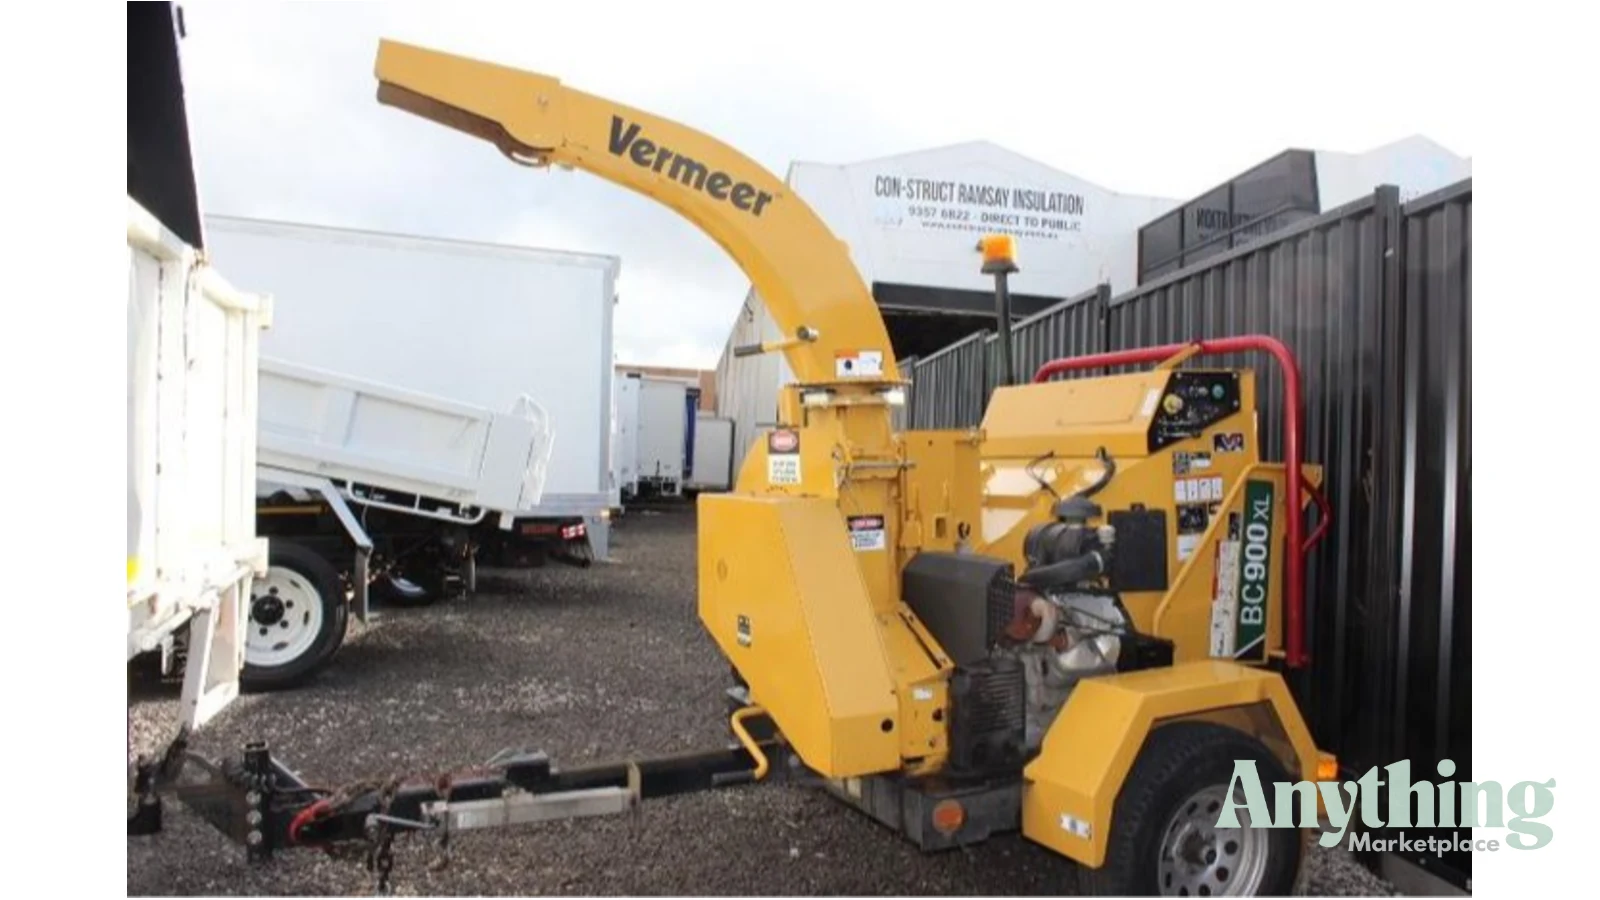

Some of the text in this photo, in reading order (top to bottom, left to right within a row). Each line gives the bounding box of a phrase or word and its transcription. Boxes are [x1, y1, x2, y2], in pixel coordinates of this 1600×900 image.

[607, 114, 773, 217] Vermeer
[874, 174, 1085, 216] CON-STRUCT RAMSAY INSULATION
[980, 211, 1020, 226] DIRECT
[1024, 215, 1039, 228] TO
[1041, 218, 1082, 232] PUBLIC
